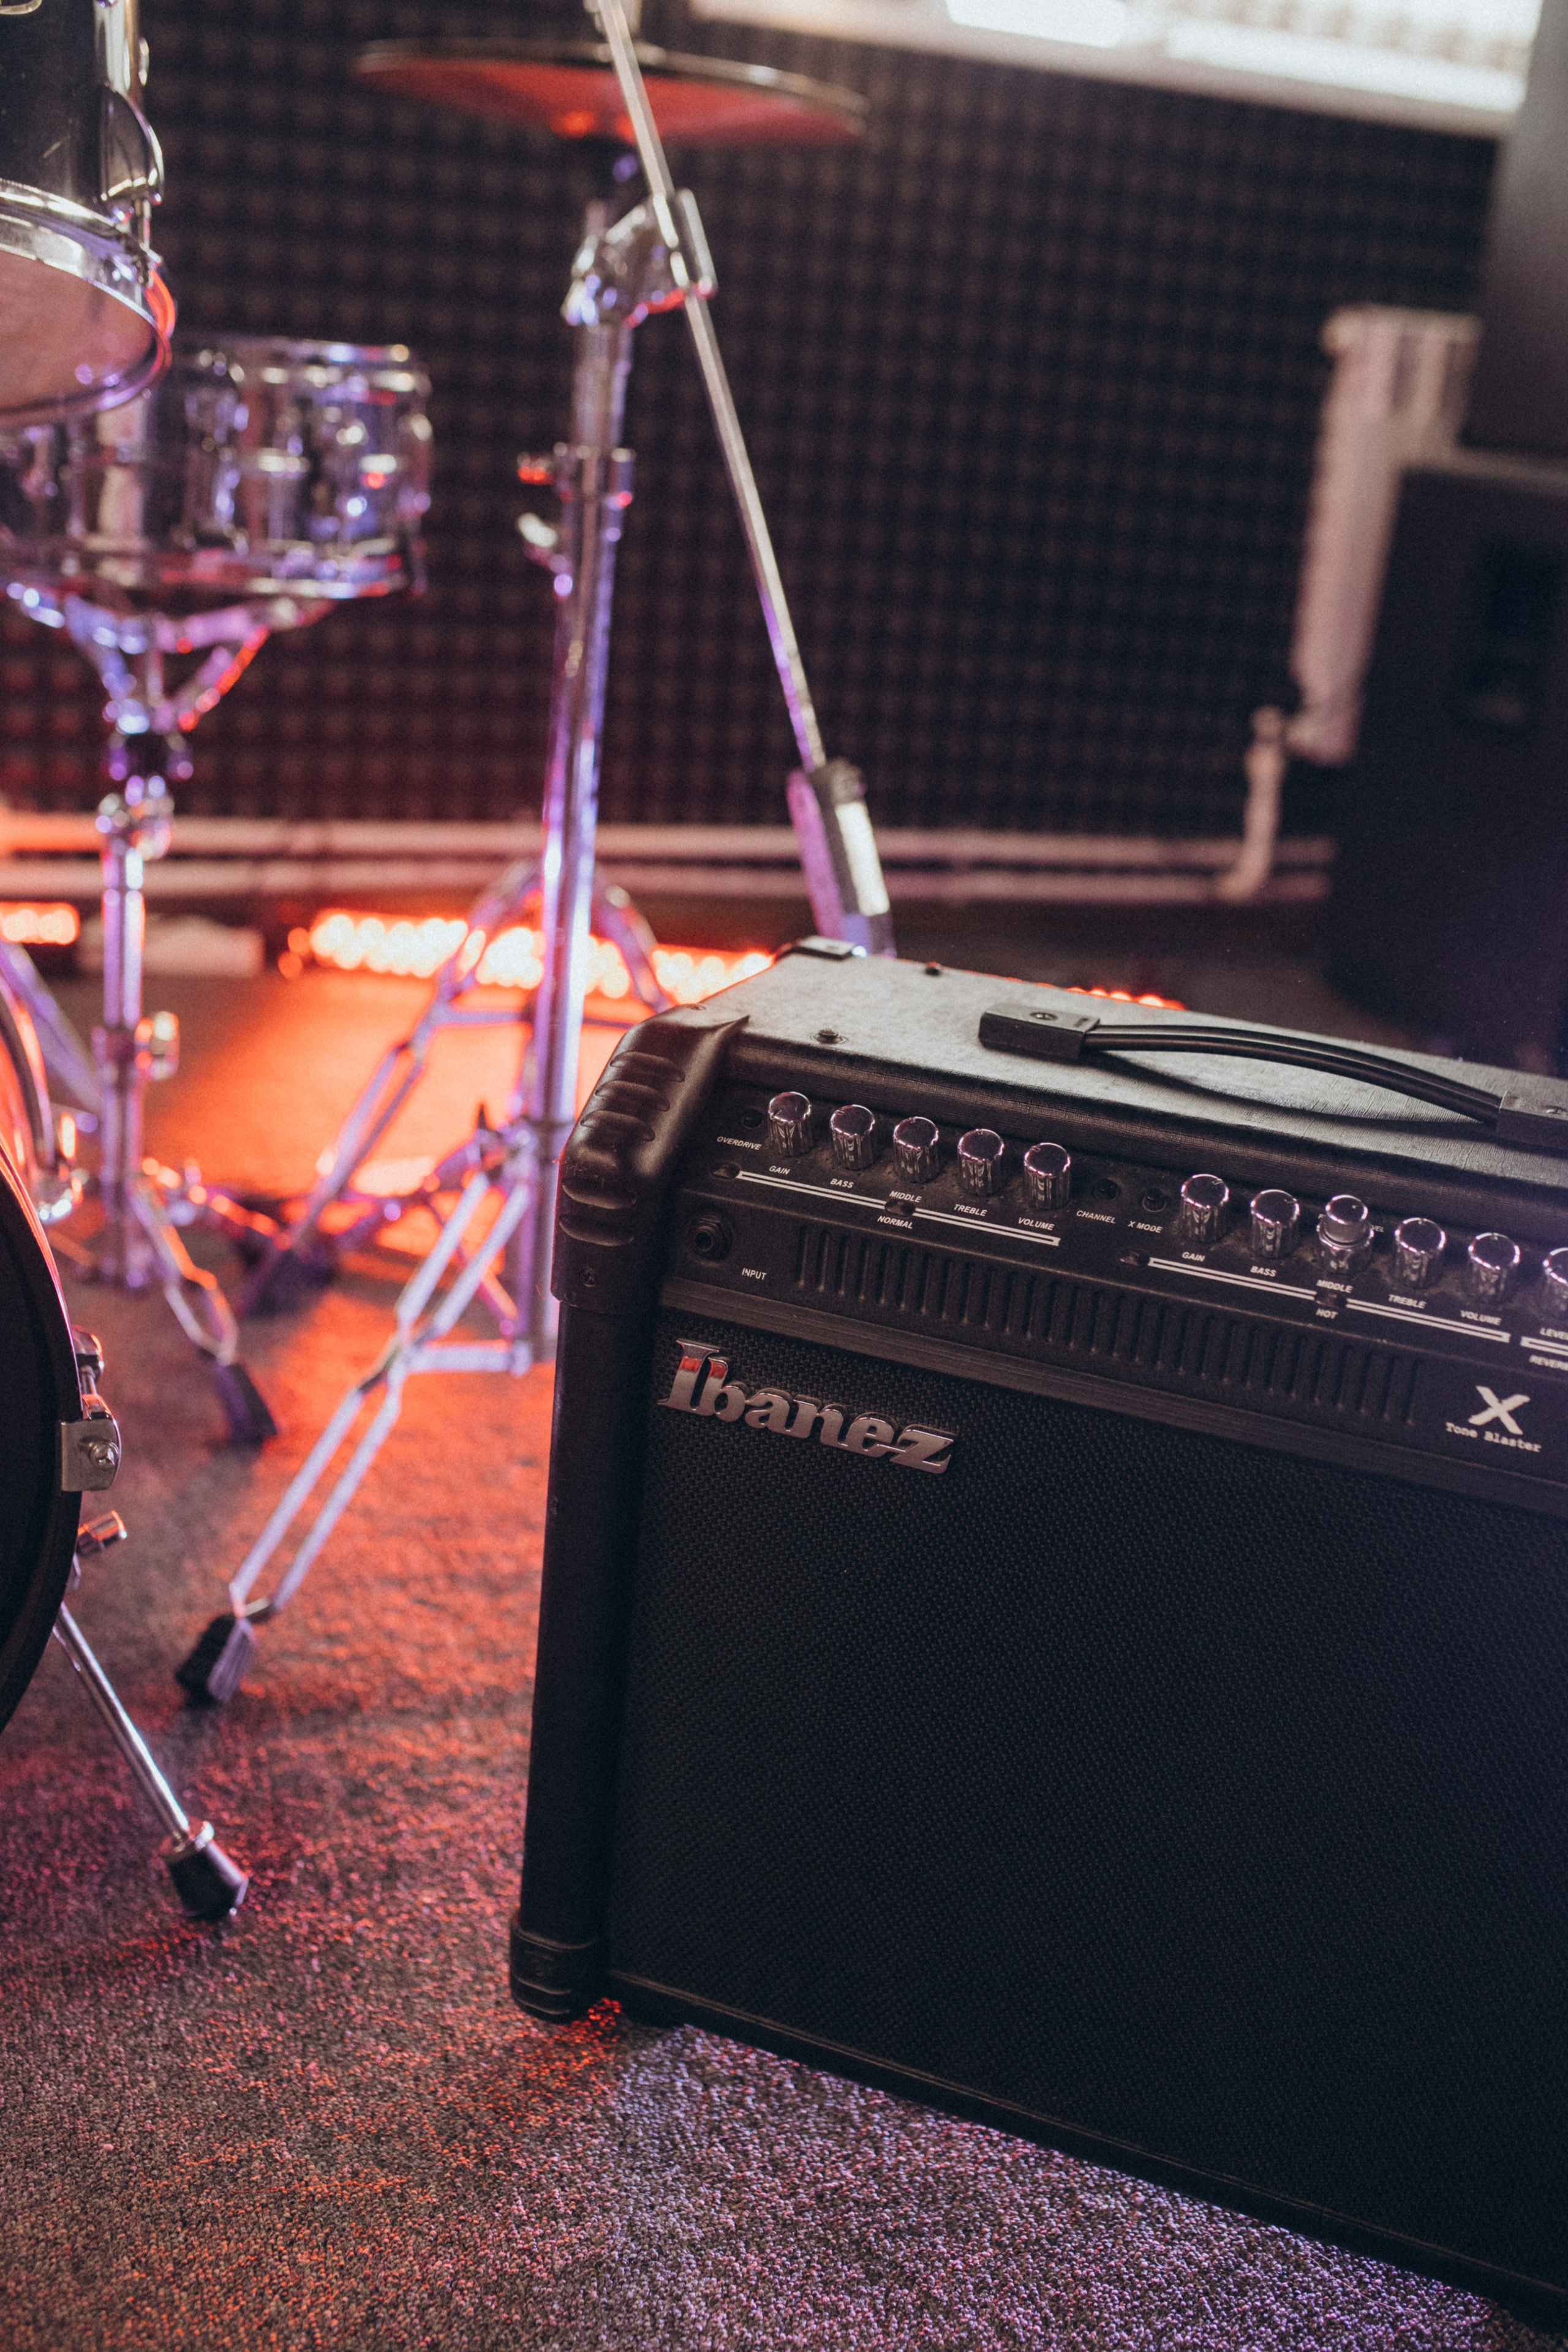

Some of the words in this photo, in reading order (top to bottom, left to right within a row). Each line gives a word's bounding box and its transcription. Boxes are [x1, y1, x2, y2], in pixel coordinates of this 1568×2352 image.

[717, 1136, 762, 1150] OVERDRIVE
[769, 1165, 791, 1175] GAIN
[830, 1178, 854, 1188] BASS
[889, 1190, 922, 1203] MIDDLE
[954, 1204, 987, 1216] TREBLE
[1076, 1210, 1116, 1224] CHANNEL
[877, 1215, 913, 1229] NORMAL
[1018, 1217, 1055, 1231] VOLUME
[1136, 1221, 1163, 1234] MODE
[1182, 1251, 1205, 1262] GAIN
[741, 1268, 767, 1280] INPUT
[1250, 1266, 1277, 1277] BASS
[1316, 1279, 1353, 1293] MIDDLE
[1388, 1294, 1427, 1309] TREBLE
[1316, 1308, 1338, 1319] HOT
[1460, 1310, 1502, 1325] VOLUME
[1539, 1327, 1568, 1341] LEVE
[657, 1338, 957, 1474] Ibanez
[1446, 1422, 1478, 1438] Tone
[1484, 1431, 1542, 1452] Blaster
